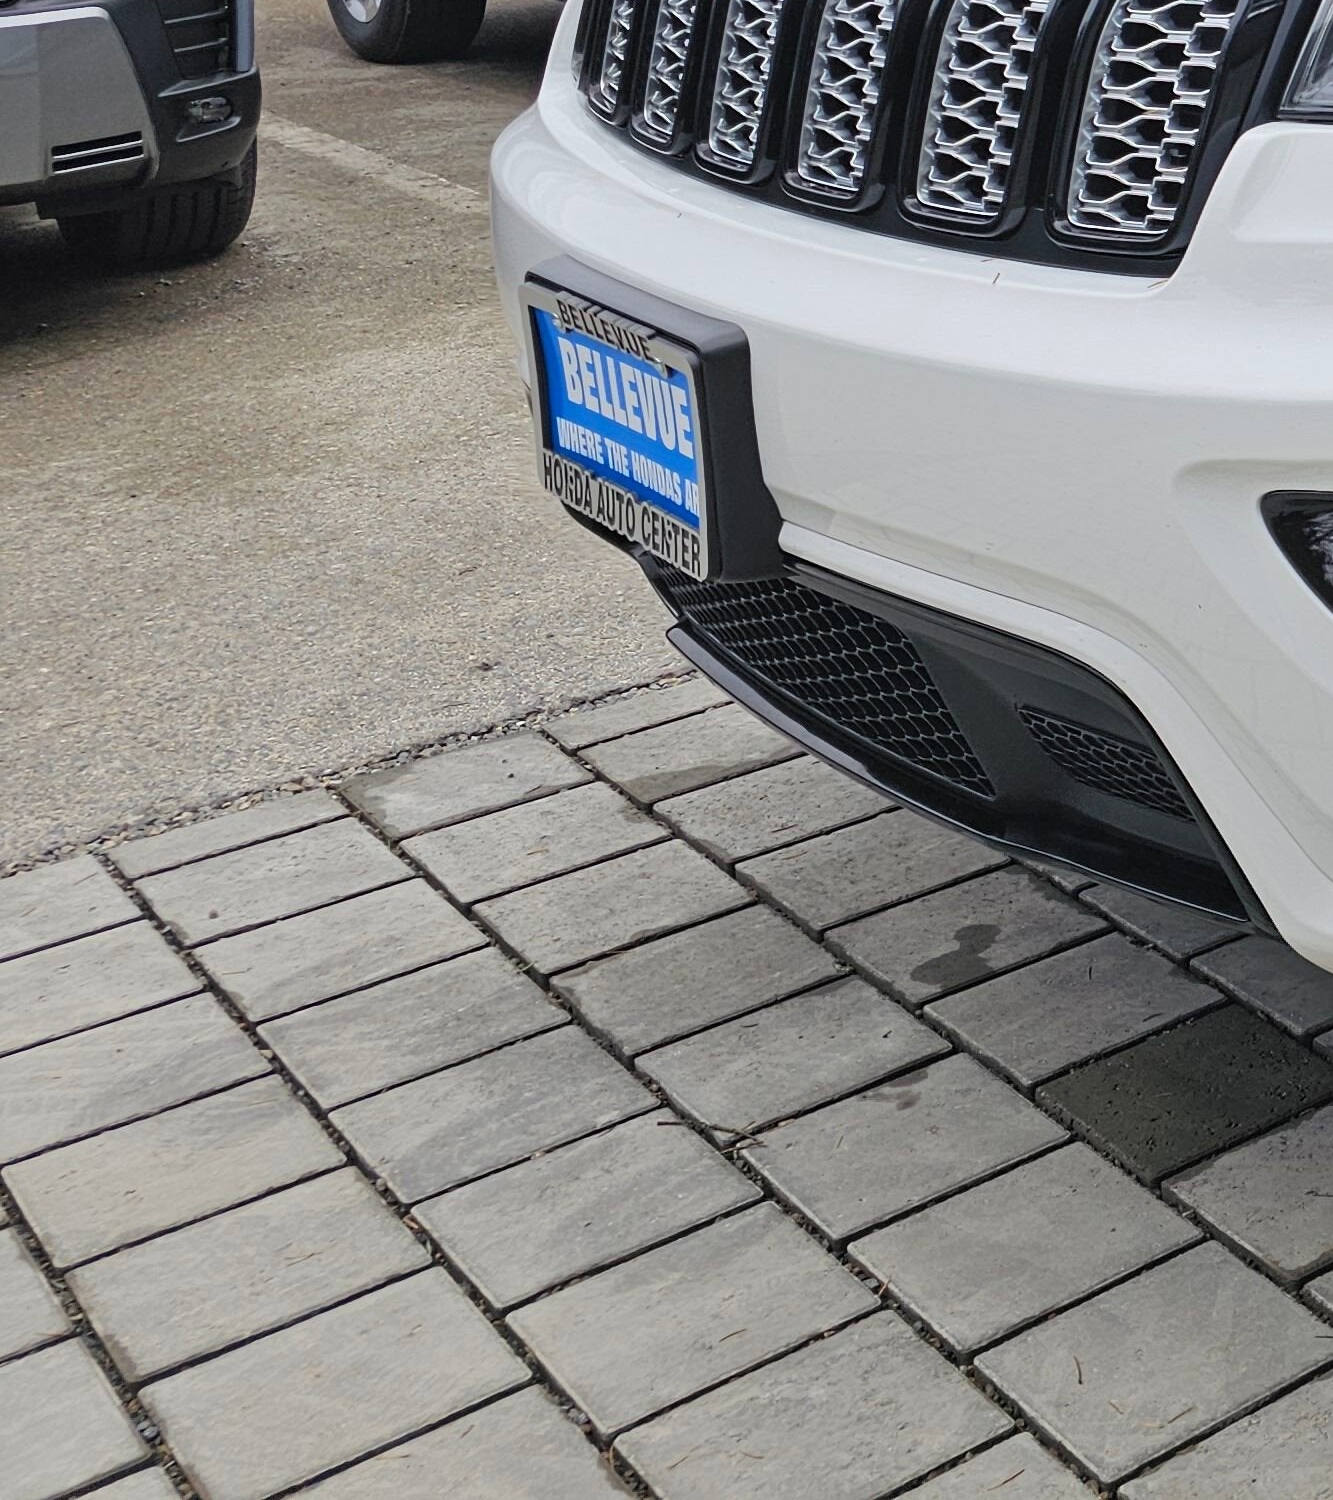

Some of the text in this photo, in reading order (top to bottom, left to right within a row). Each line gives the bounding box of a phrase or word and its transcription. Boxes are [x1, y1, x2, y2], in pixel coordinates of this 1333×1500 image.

[556, 298, 654, 362] BELLEVUE
[557, 336, 694, 460] BELLEVUE
[542, 451, 700, 577] HONDA AUTO CENTER
[556, 417, 604, 465] WHERE
[604, 436, 630, 477] THE
[631, 449, 682, 507] HONDAS
